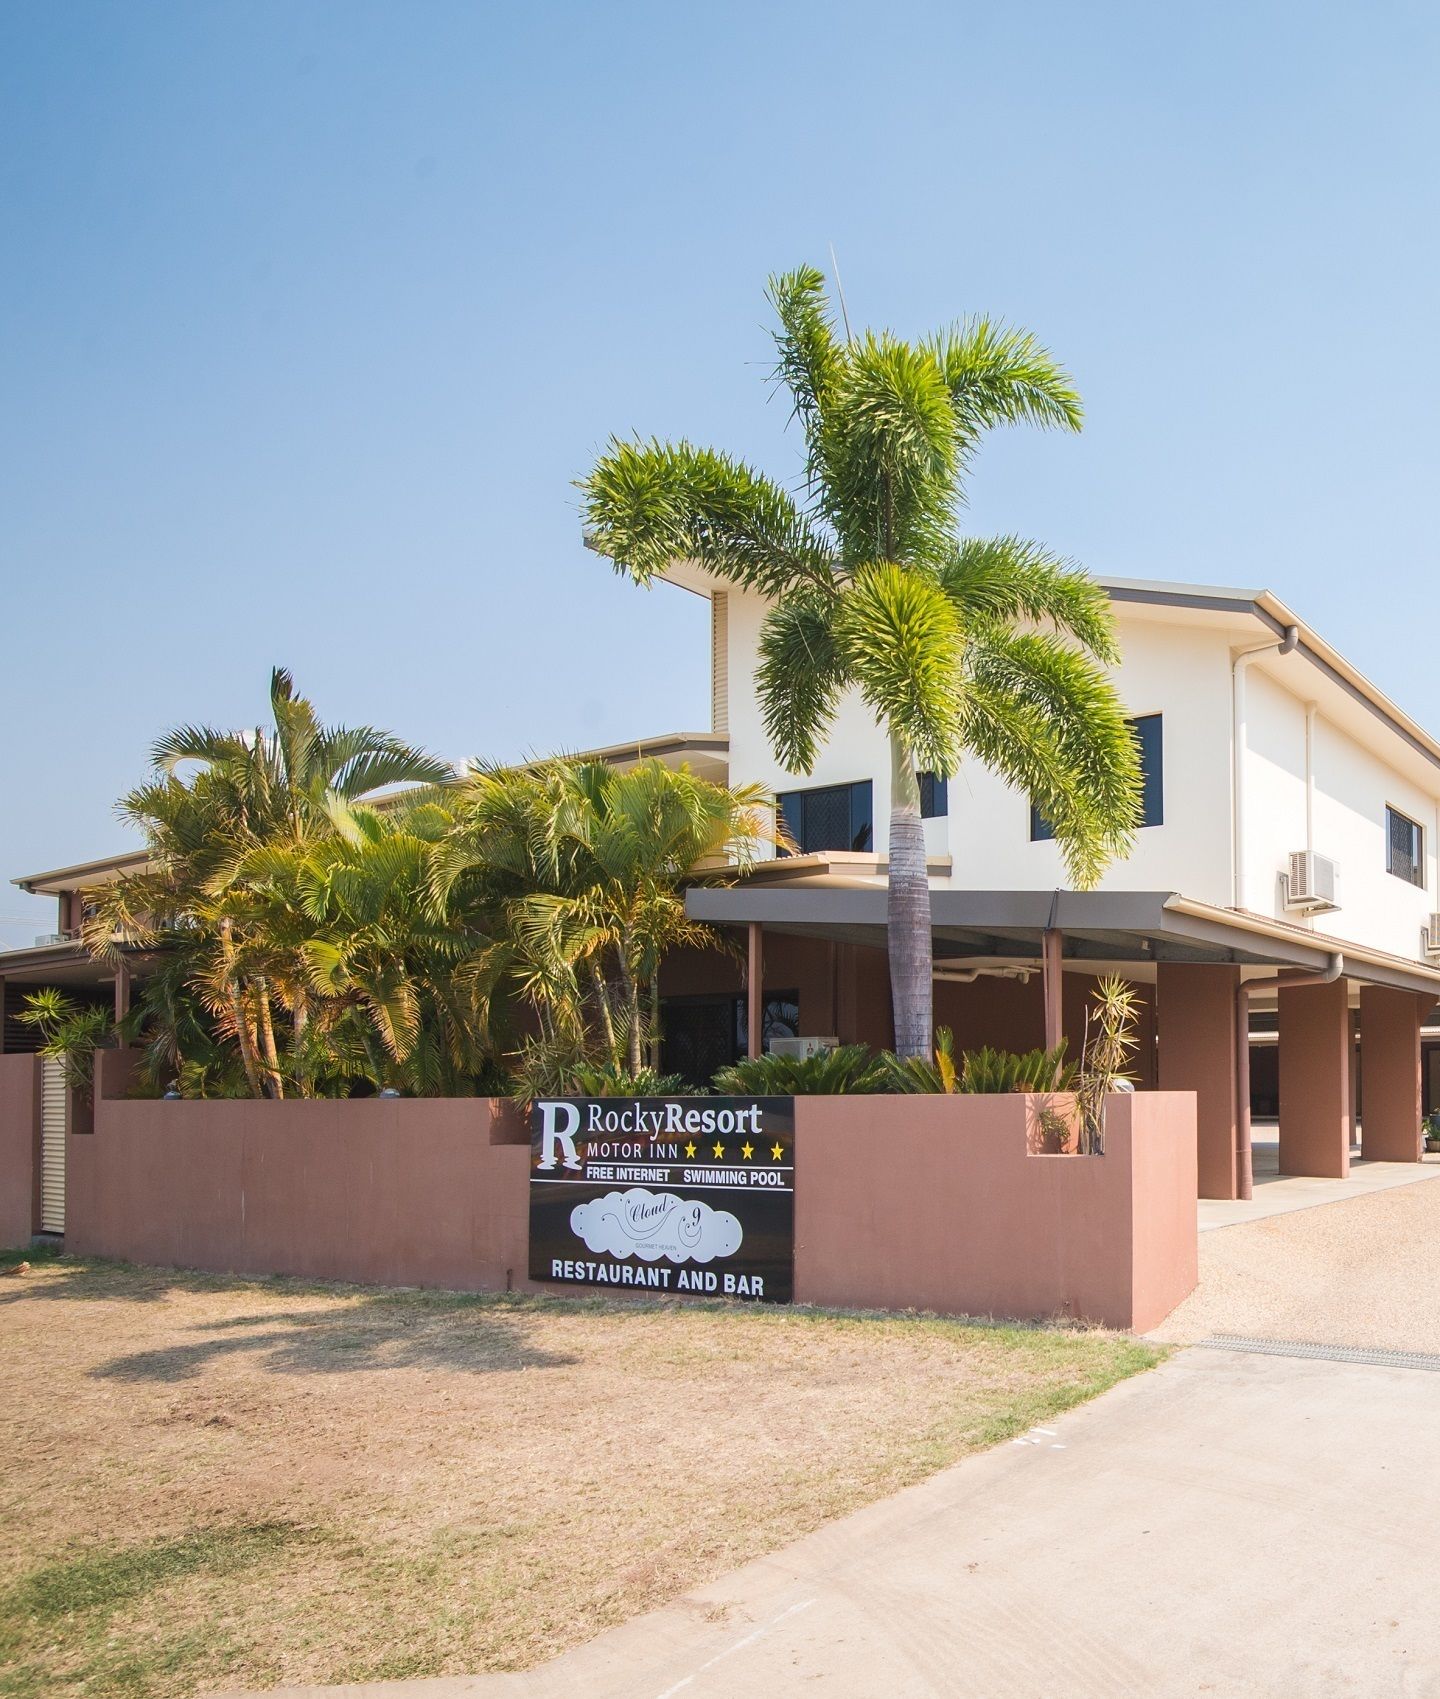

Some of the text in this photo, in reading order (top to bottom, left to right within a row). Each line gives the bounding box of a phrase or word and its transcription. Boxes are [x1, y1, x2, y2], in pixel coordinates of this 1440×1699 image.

[537, 1102, 582, 1170] R
[587, 1102, 763, 1141] RockyResort
[587, 1142, 678, 1159] MOTOR INN
[587, 1167, 785, 1186] FREE INTERNET SWIMMING POOL
[630, 1195, 701, 1226] Cloud 9
[552, 1259, 764, 1296] RESTAURANT AND BAR
